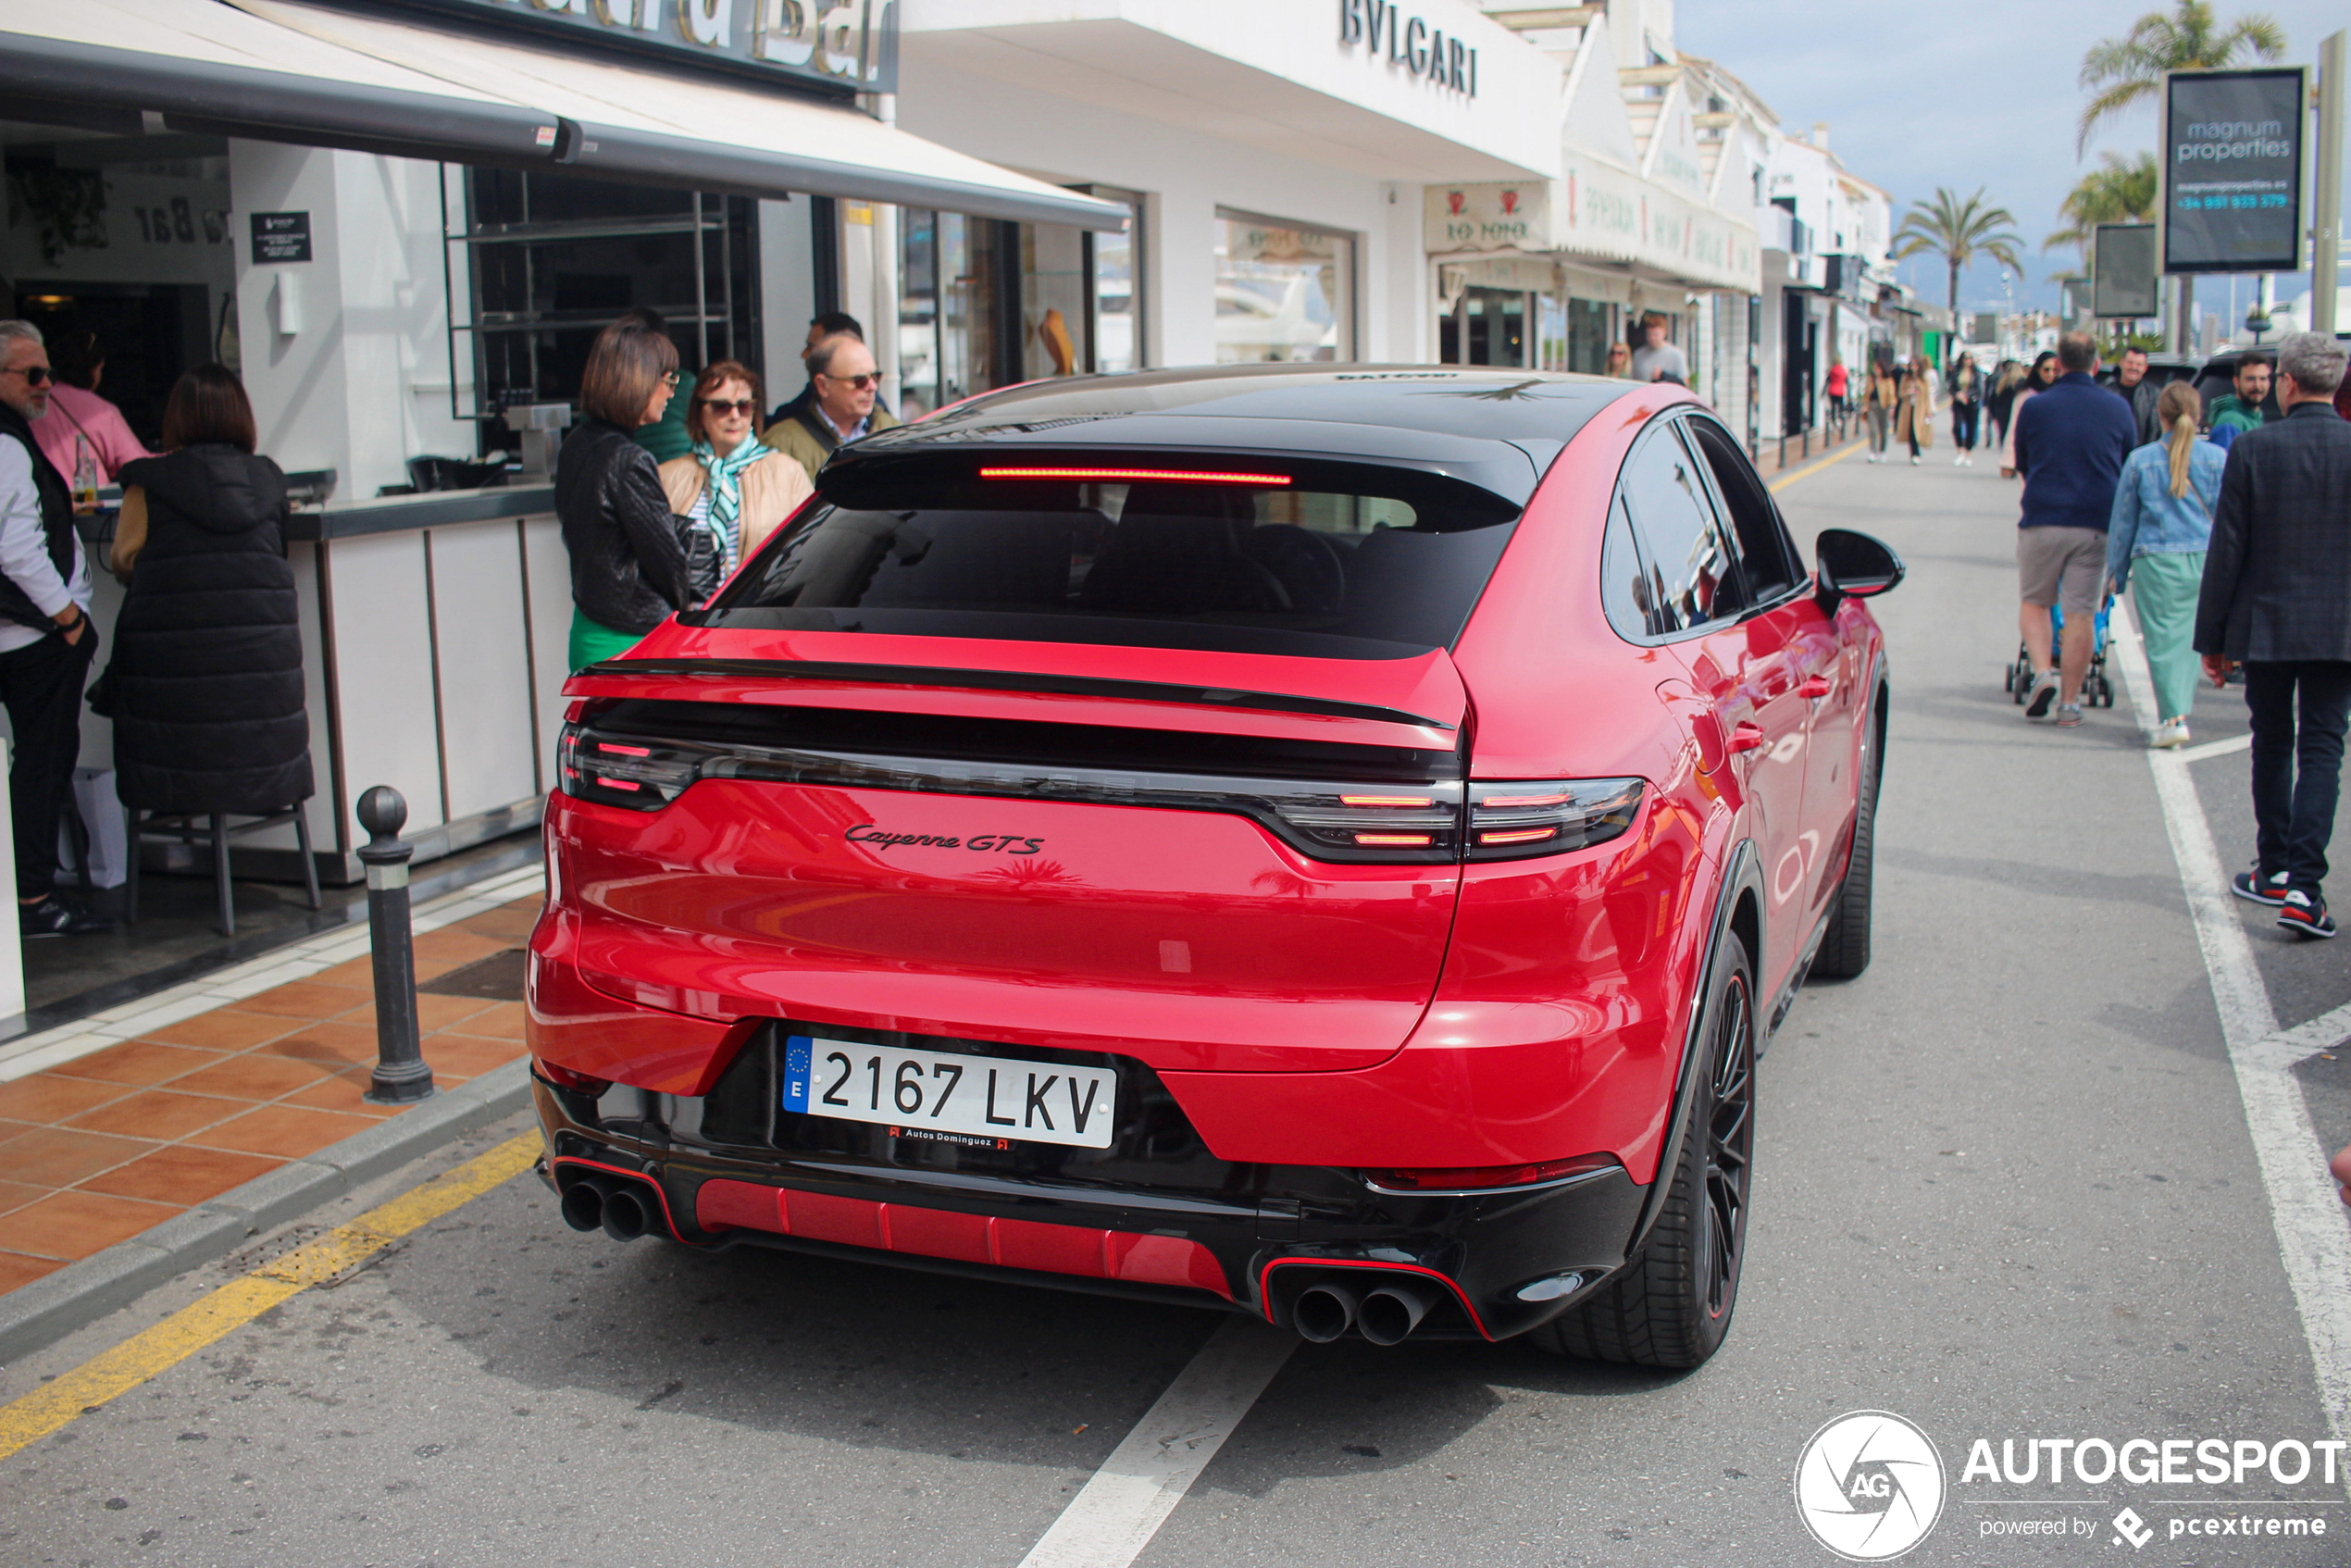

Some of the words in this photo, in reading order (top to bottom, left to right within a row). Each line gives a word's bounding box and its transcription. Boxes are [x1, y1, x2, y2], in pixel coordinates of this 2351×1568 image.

[1339, 0, 1477, 100] BVLGARI
[2187, 120, 2282, 143] magnum
[2177, 137, 2291, 165] properties
[845, 824, 961, 851] Cayenne
[966, 835, 1045, 854] GTS
[791, 1081, 802, 1098] E
[822, 1052, 964, 1118] 2167
[986, 1068, 1100, 1134] LKV
[906, 1128, 935, 1139] Autos
